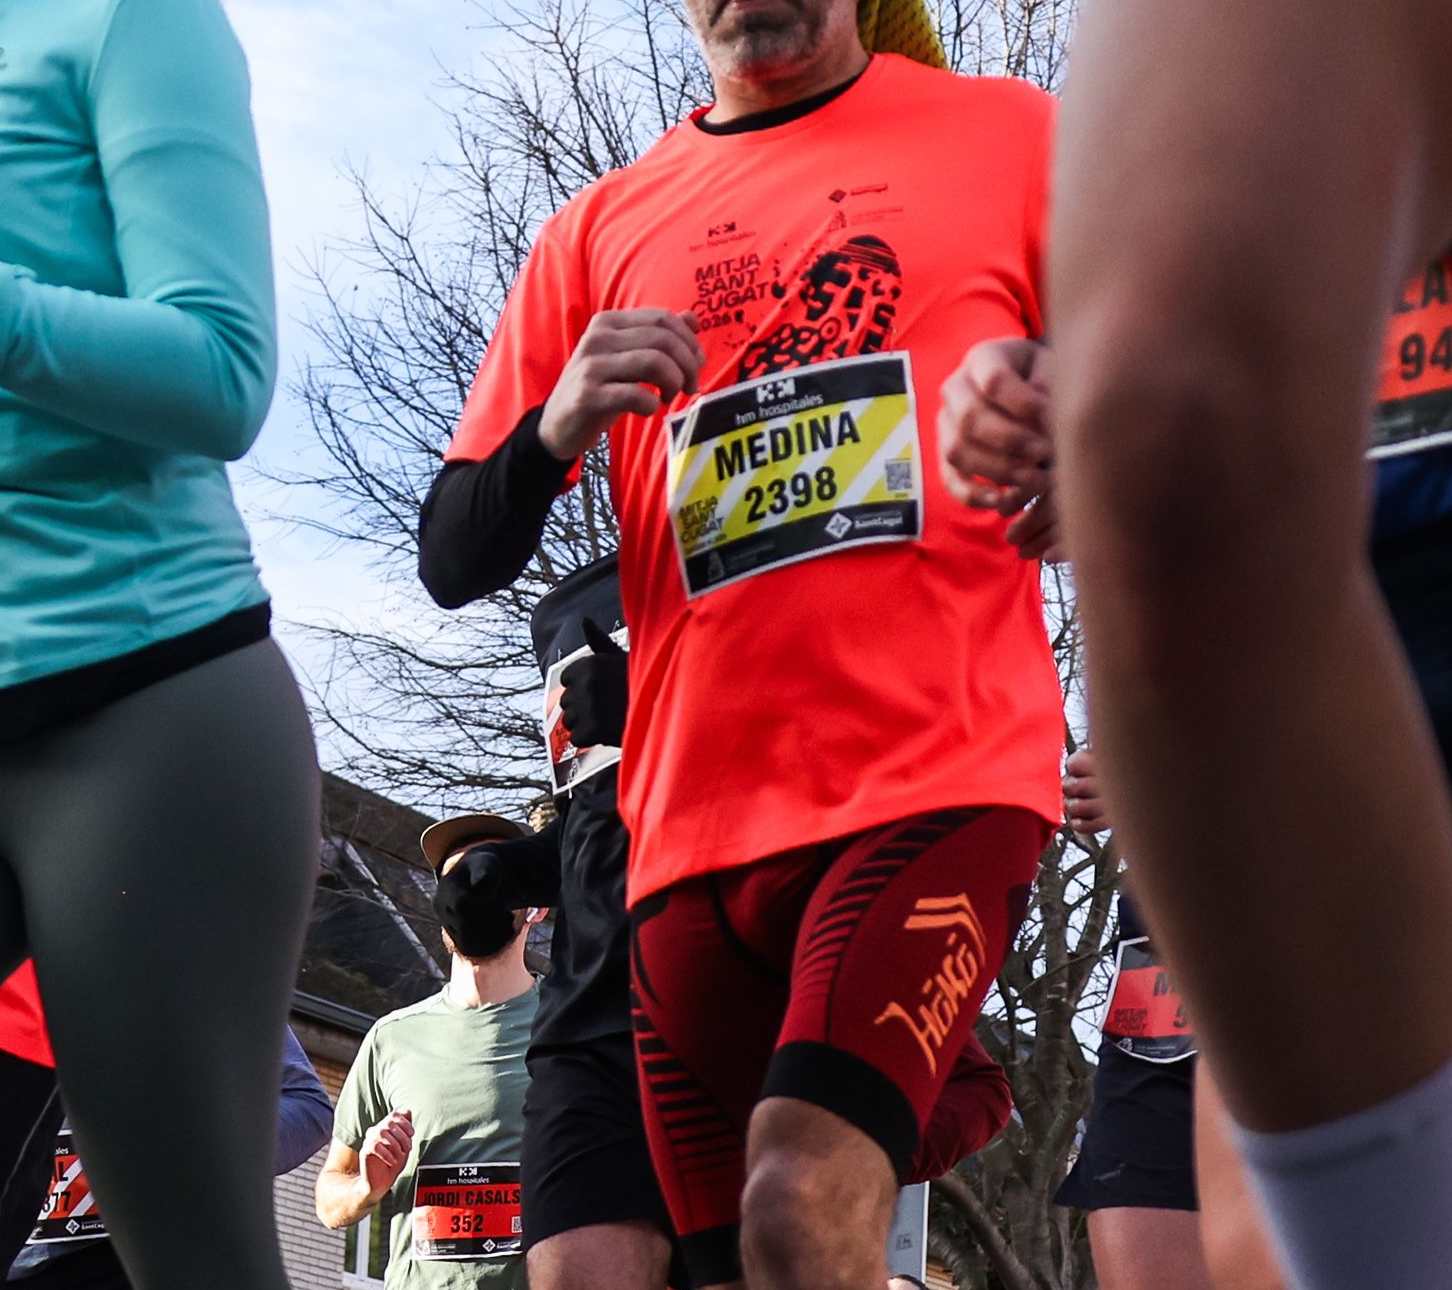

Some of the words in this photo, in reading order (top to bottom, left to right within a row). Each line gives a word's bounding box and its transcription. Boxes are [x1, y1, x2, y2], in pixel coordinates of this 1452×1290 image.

[695, 253, 760, 282] MITJA
[697, 268, 758, 298] SANT
[735, 410, 757, 426] hm
[759, 393, 824, 419] hospitales
[713, 411, 861, 482] MEDINA
[744, 466, 838, 524] 2398
[424, 1191, 461, 1207] JORDI
[465, 1189, 521, 1206] CASALS
[450, 1214, 485, 1234] 352
